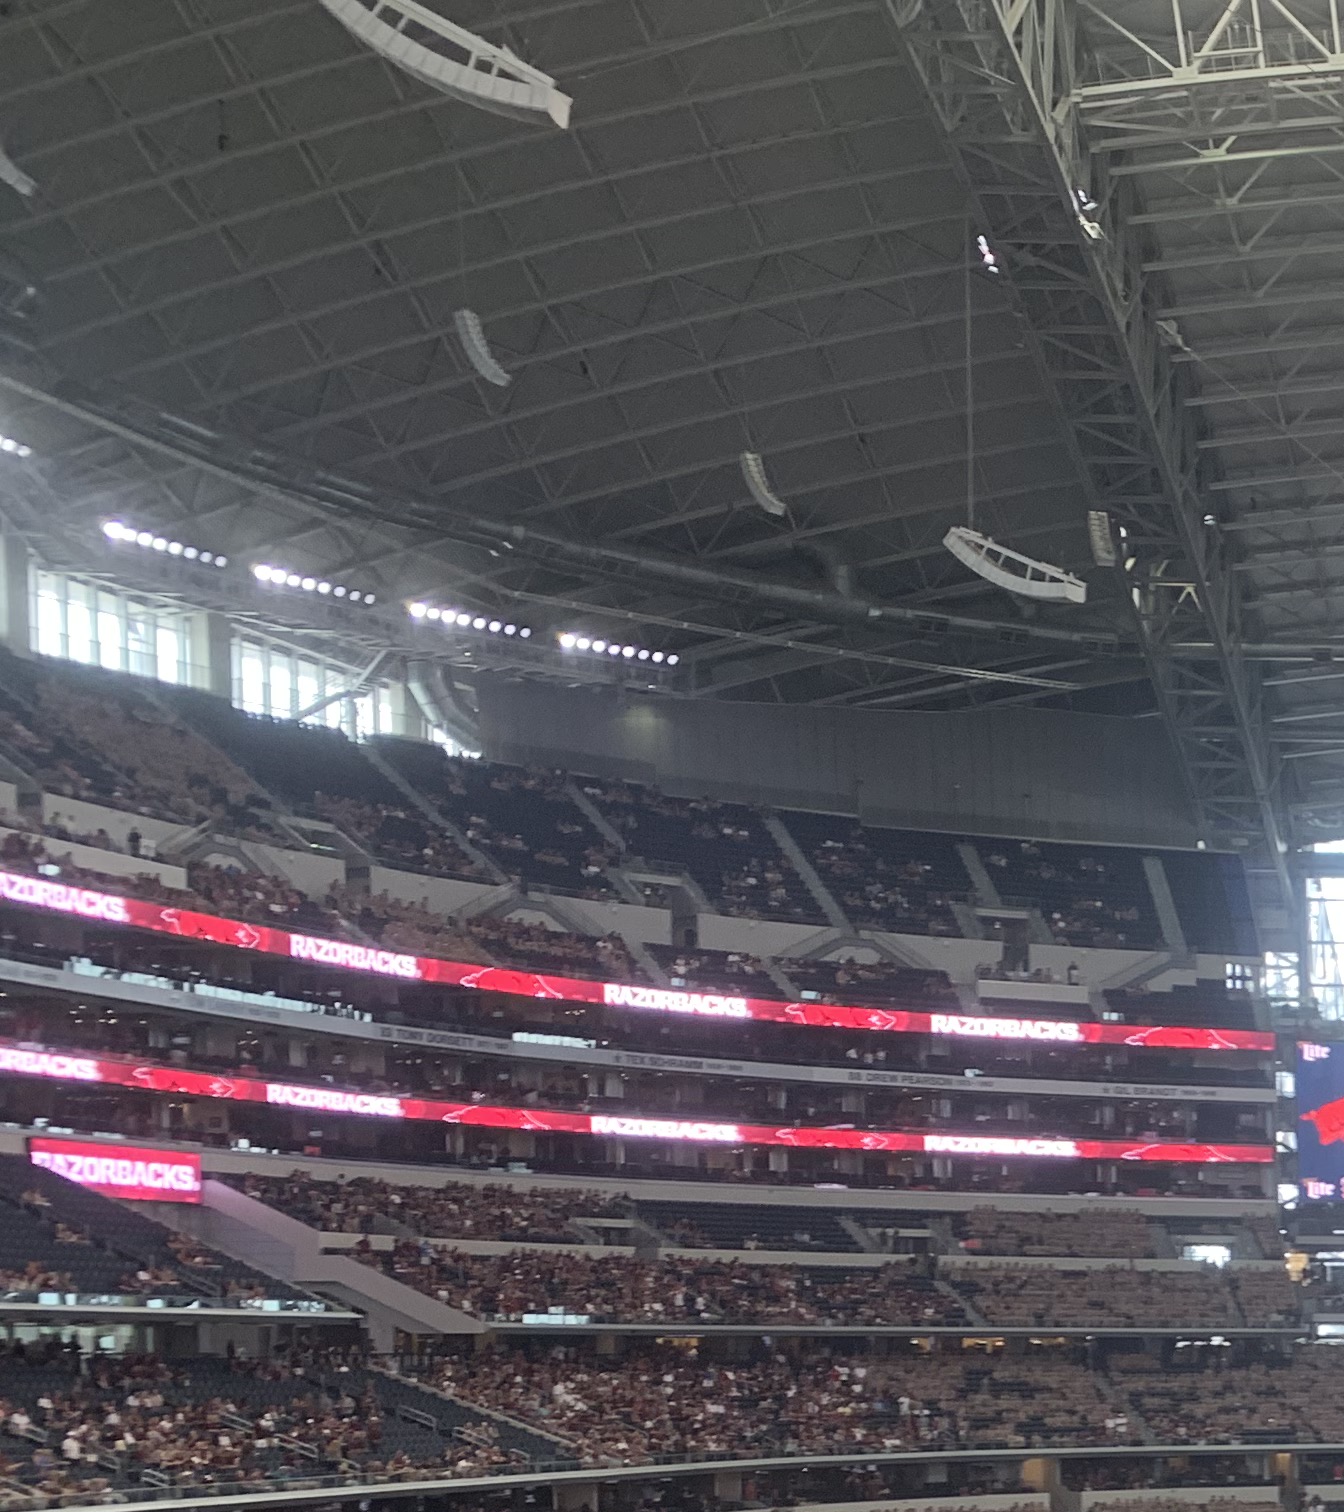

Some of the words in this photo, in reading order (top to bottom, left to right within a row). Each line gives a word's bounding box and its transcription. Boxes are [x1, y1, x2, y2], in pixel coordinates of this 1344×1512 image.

[0, 872, 127, 922] AZORBACKS
[289, 934, 418, 978] RAZORBACKS
[603, 983, 748, 1017] RAZORBACKS
[930, 1013, 1080, 1041] RAZORBACKS
[1302, 1043, 1331, 1061] Lite
[265, 1083, 402, 1117] RAZORBACKS
[590, 1115, 739, 1142] RAZORBACKS
[923, 1134, 1077, 1157] RAZORBACKS
[31, 1151, 196, 1190] RAZORBACKS
[1307, 1181, 1336, 1199] Lite
